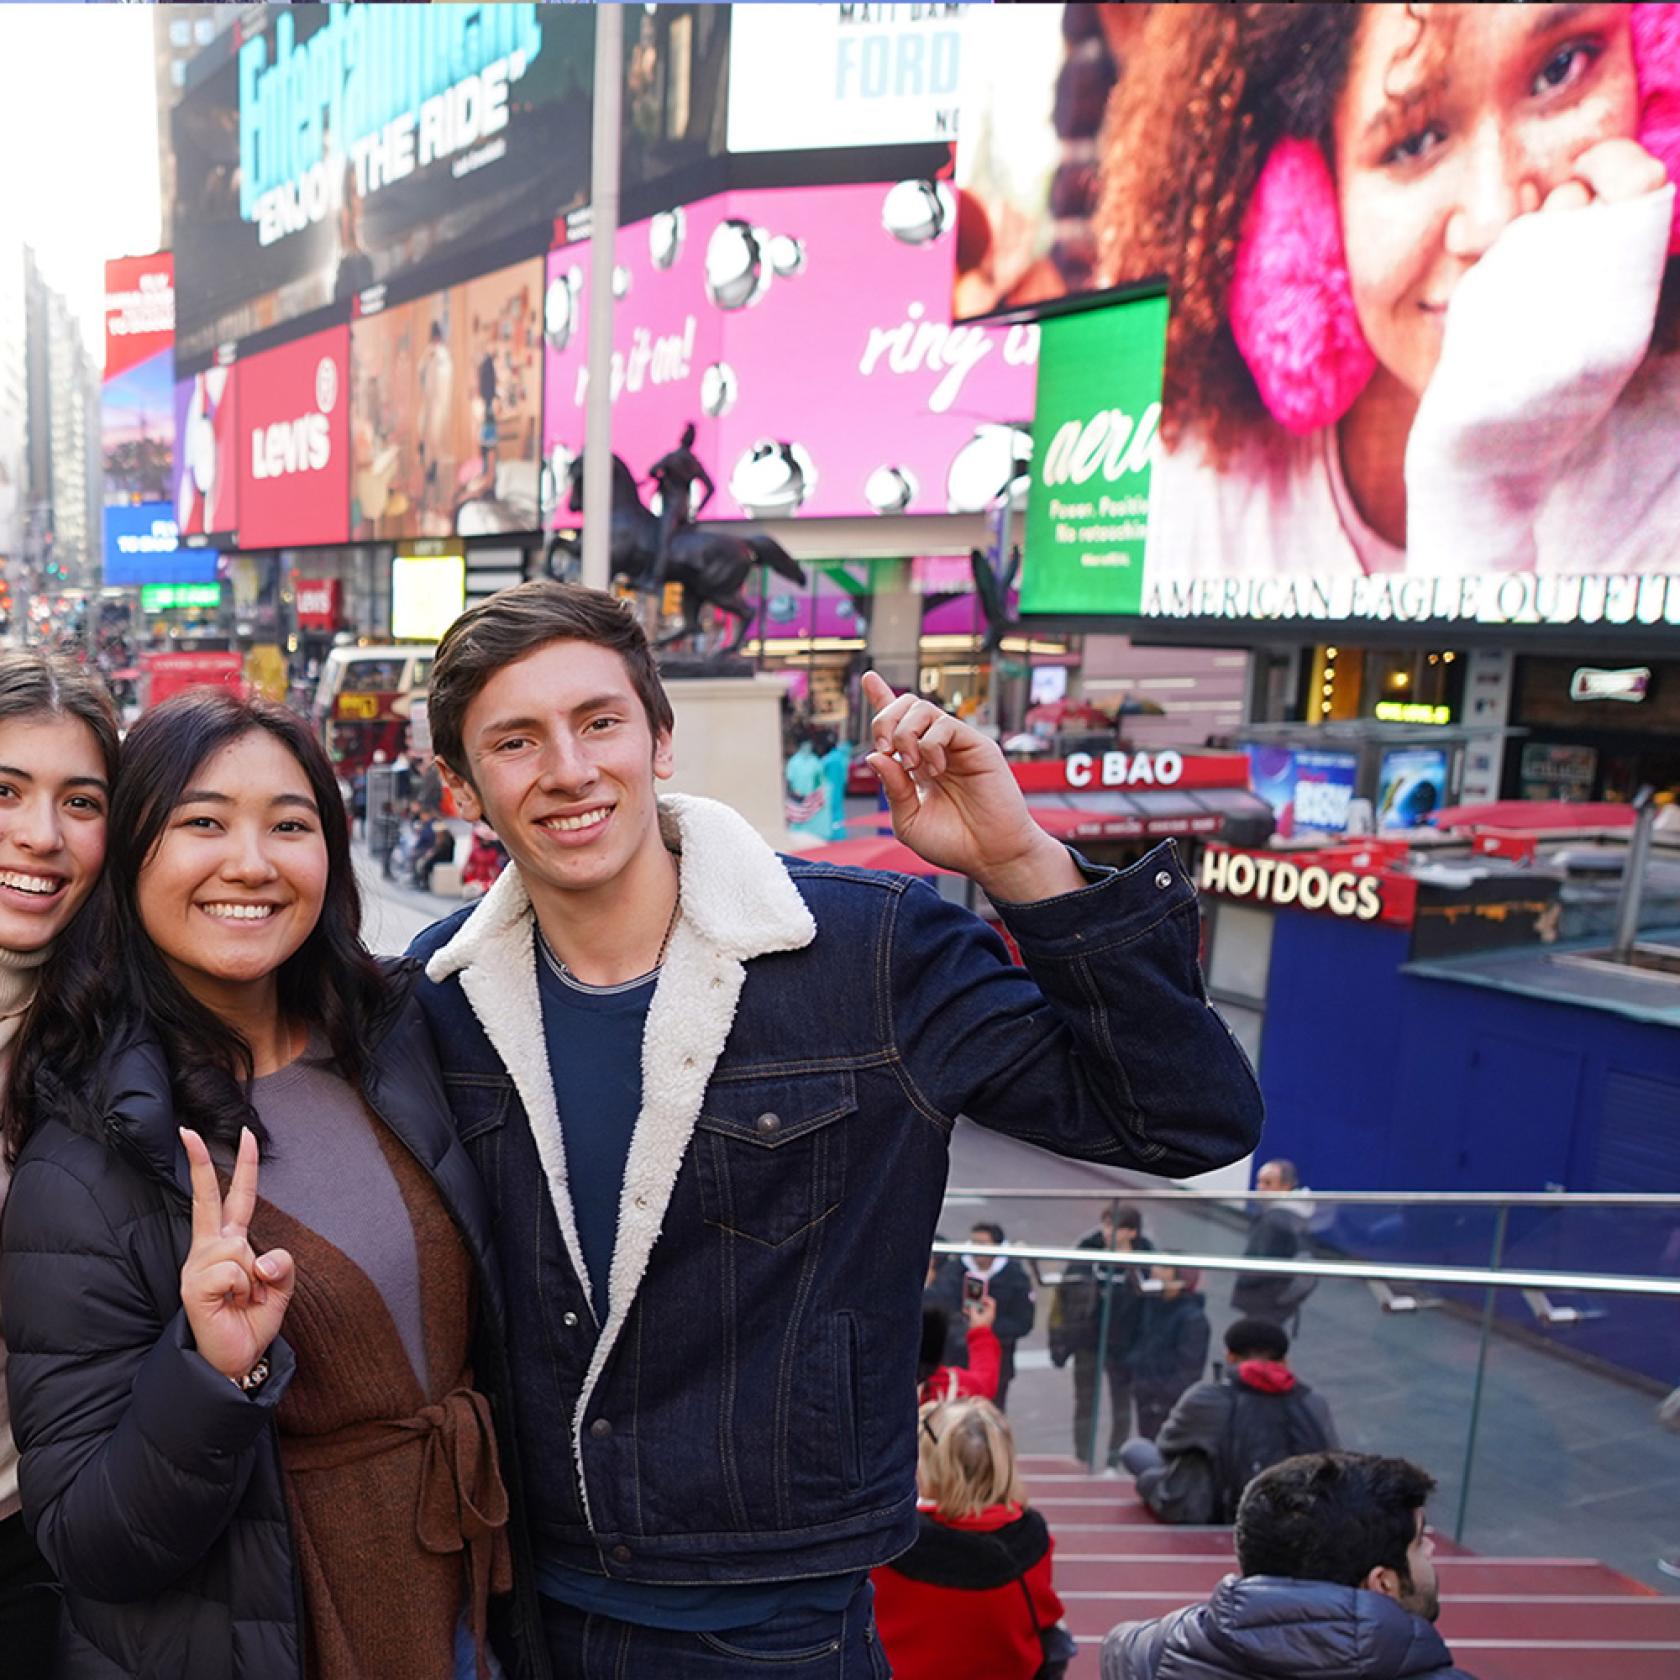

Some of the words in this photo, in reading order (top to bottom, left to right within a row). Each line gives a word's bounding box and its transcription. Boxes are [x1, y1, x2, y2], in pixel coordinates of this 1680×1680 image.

[836, 31, 961, 100] FORD
[351, 110, 415, 198] THE
[1147, 577, 1332, 618] AMERICAN
[1349, 574, 1483, 621] EAGLE
[1064, 752, 1094, 788] C
[1101, 750, 1183, 787] BAO
[1200, 849, 1382, 920] HOTDOGS
